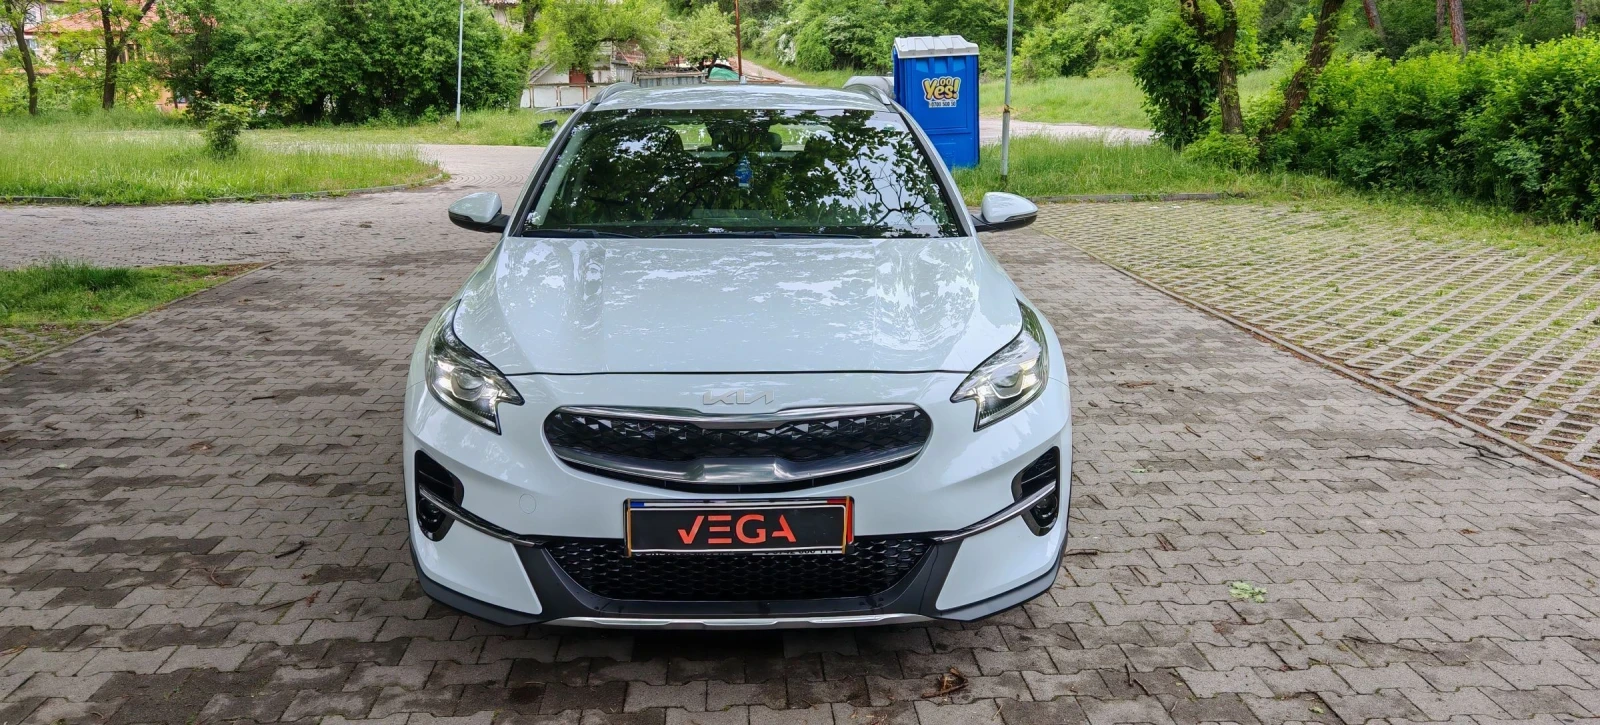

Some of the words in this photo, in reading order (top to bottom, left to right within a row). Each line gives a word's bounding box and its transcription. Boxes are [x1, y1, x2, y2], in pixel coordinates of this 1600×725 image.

[924, 79, 960, 100] Yes!
[703, 388, 775, 405] KIA
[677, 513, 797, 545] VEGA
